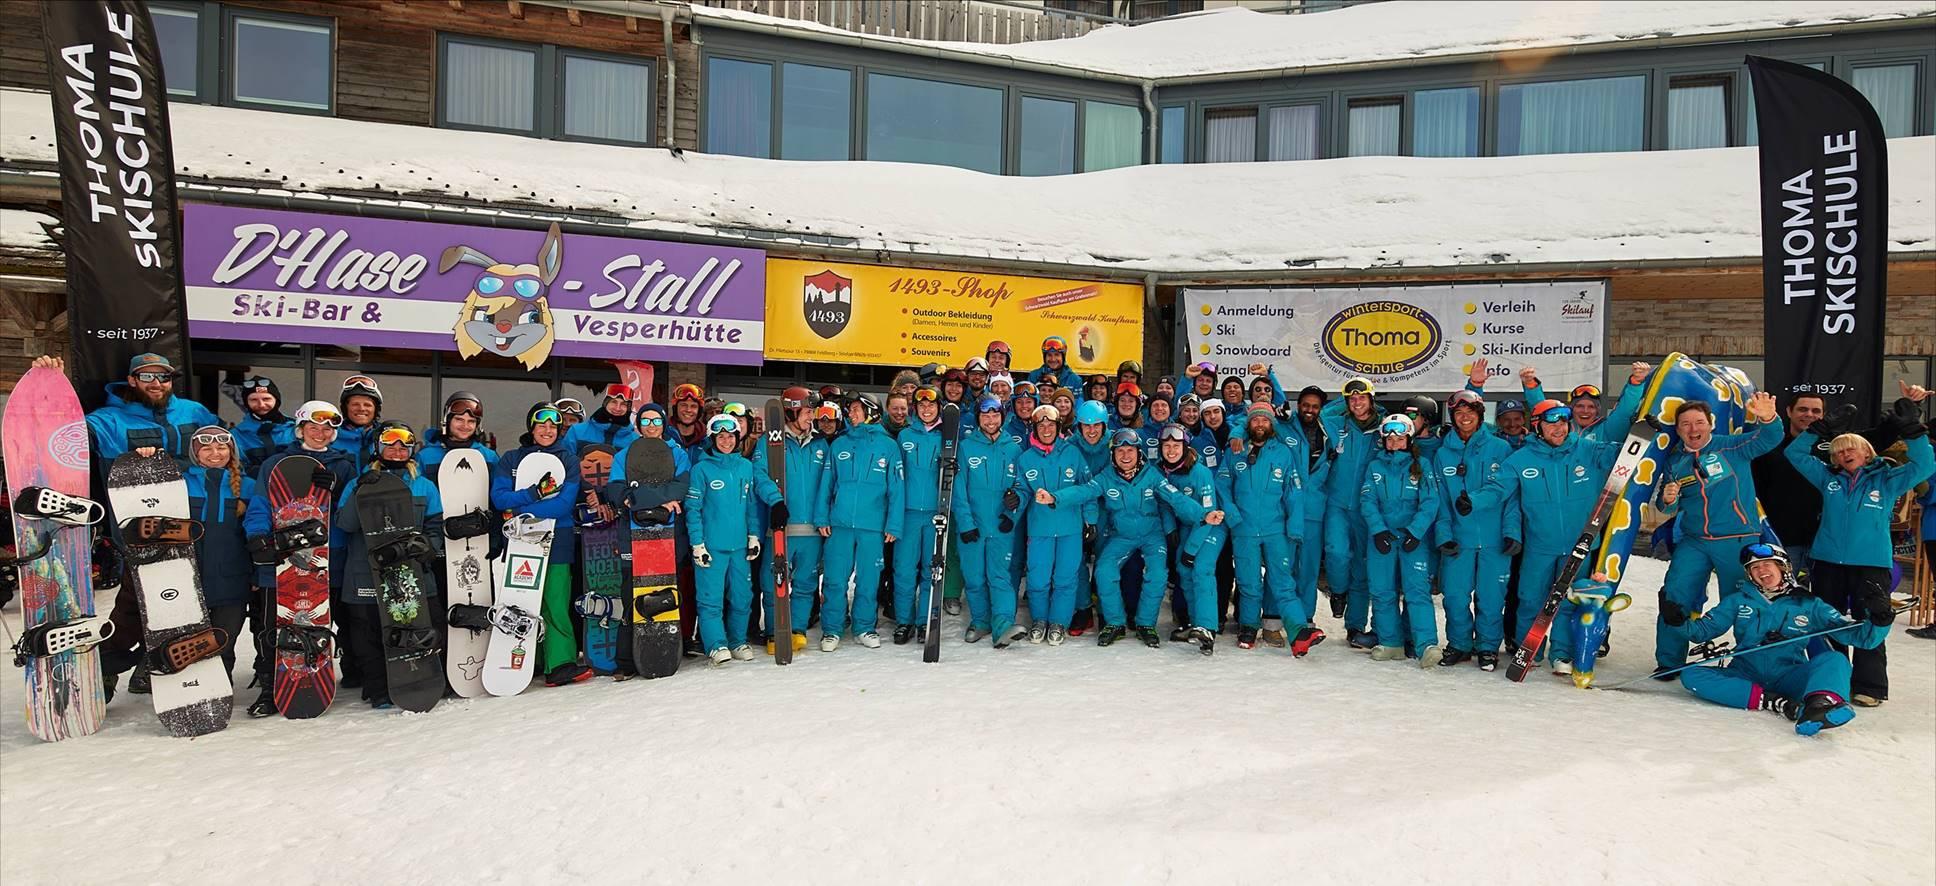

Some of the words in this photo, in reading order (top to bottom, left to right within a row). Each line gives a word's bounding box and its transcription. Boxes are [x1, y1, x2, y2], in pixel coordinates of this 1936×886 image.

[61, 43, 118, 224] THOMA
[105, 5, 162, 269] SKISCHULE
[1782, 168, 1816, 306] THOMA
[1823, 129, 1858, 335] SKISCHULE
[212, 223, 428, 294] D'Hase
[888, 276, 1015, 308] 1493-Shop
[232, 294, 353, 322] Ski-Bar
[361, 301, 383, 324] &
[1216, 304, 1294, 319] Anmeldung
[1482, 300, 1536, 313] Verleih
[1561, 303, 1594, 319] Skilauf
[808, 309, 845, 324] 1493
[912, 308, 946, 317] Outdoor
[948, 310, 993, 322] Bekleidung
[573, 314, 742, 344] Vesperhütte
[960, 321, 971, 329] und
[1216, 324, 1236, 336] Ski
[1482, 322, 1525, 335] Kurse
[97, 327, 128, 340] seit
[131, 327, 159, 340] 1937
[911, 332, 957, 343] Accessoires
[1341, 328, 1420, 346] Thoma
[911, 347, 951, 358] Souvenirs
[1216, 345, 1291, 357] Snowboard
[1482, 341, 1592, 356] Ski-Kinderland
[1313, 342, 1321, 354] Die
[1318, 352, 1343, 375] Agentur
[1390, 366, 1431, 383] Kompetenz
[1430, 359, 1440, 369] im
[1437, 339, 1452, 360] Sport
[1354, 362, 1405, 375] schule
[1216, 364, 1274, 378] Langlf
[1484, 363, 1511, 377] nfo
[1814, 384, 1846, 394] 1937
